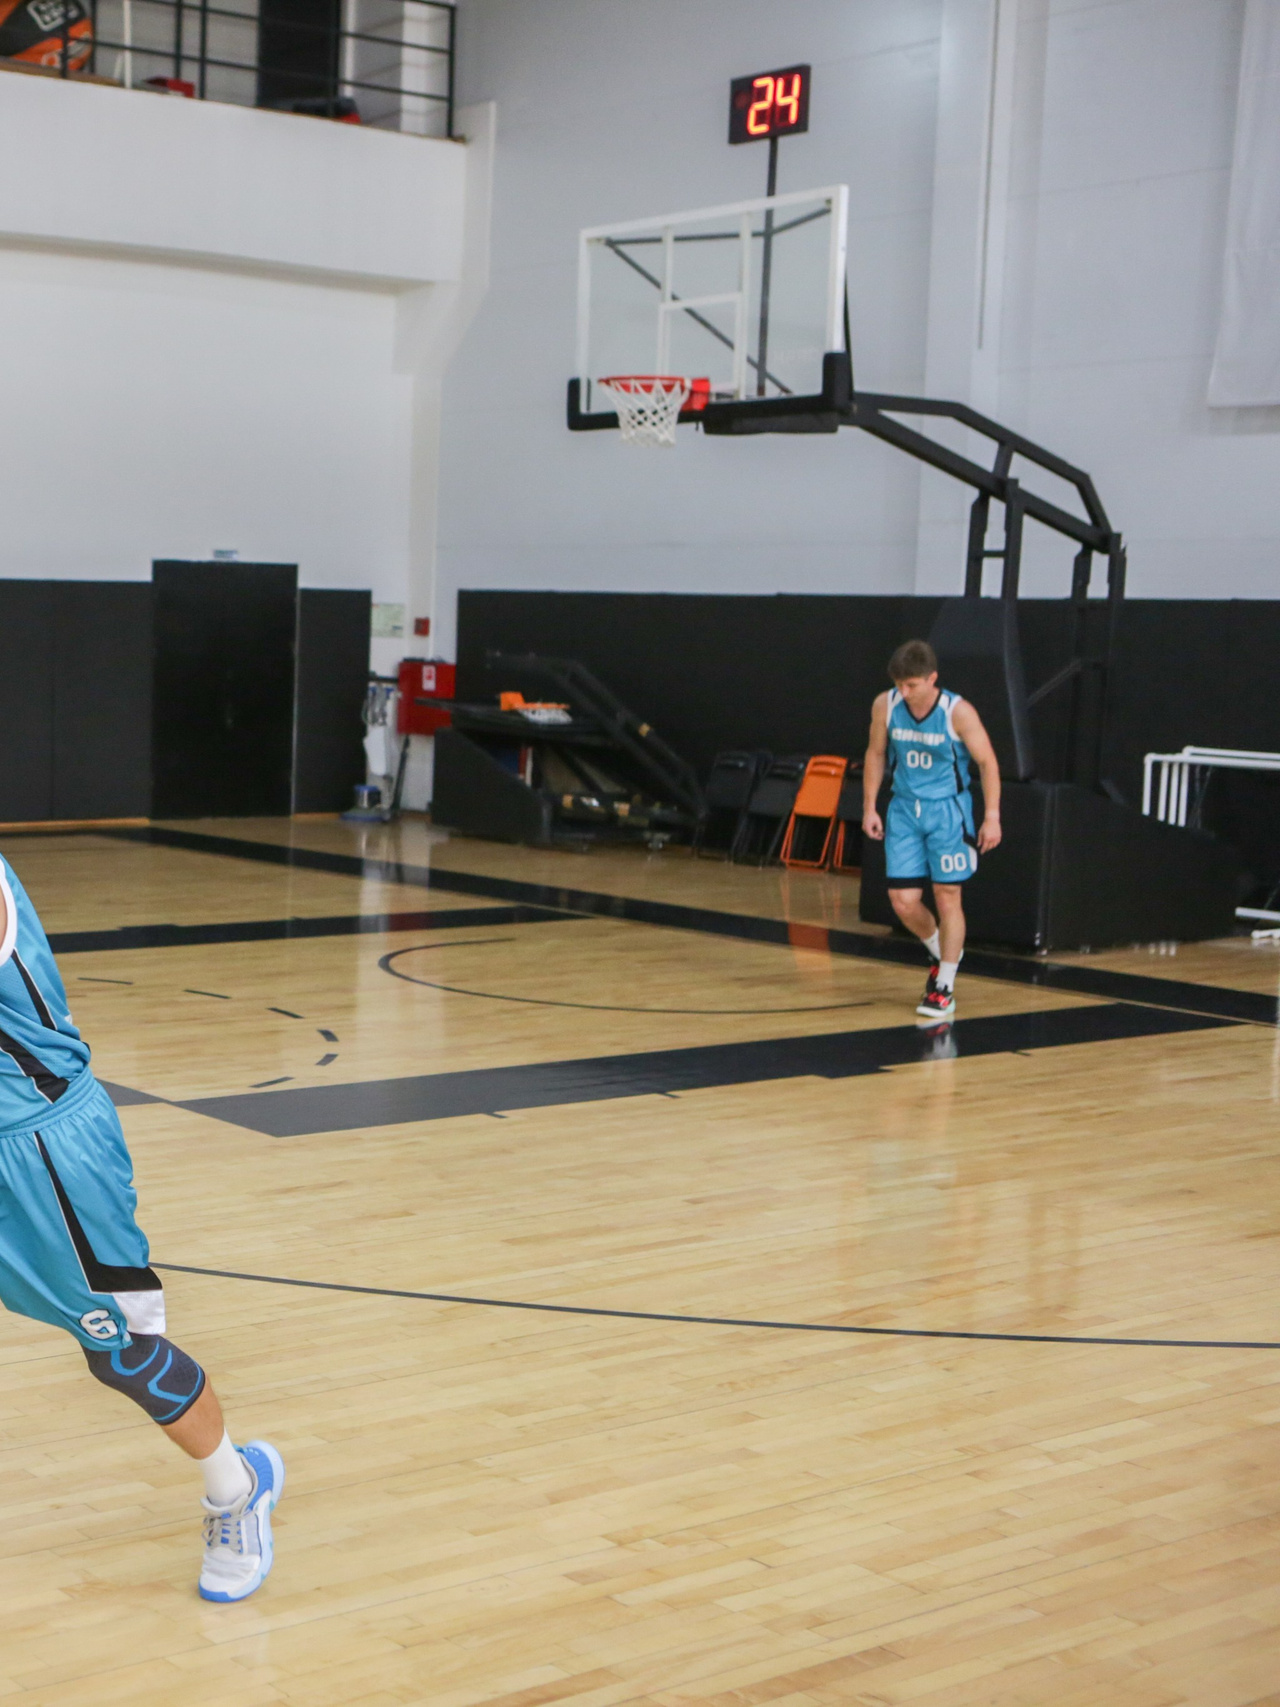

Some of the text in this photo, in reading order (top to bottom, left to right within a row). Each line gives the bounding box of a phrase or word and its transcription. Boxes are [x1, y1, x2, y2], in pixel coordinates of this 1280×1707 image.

[747, 74, 801, 135] 24
[906, 750, 932, 769] 00
[941, 852, 967, 873] 00
